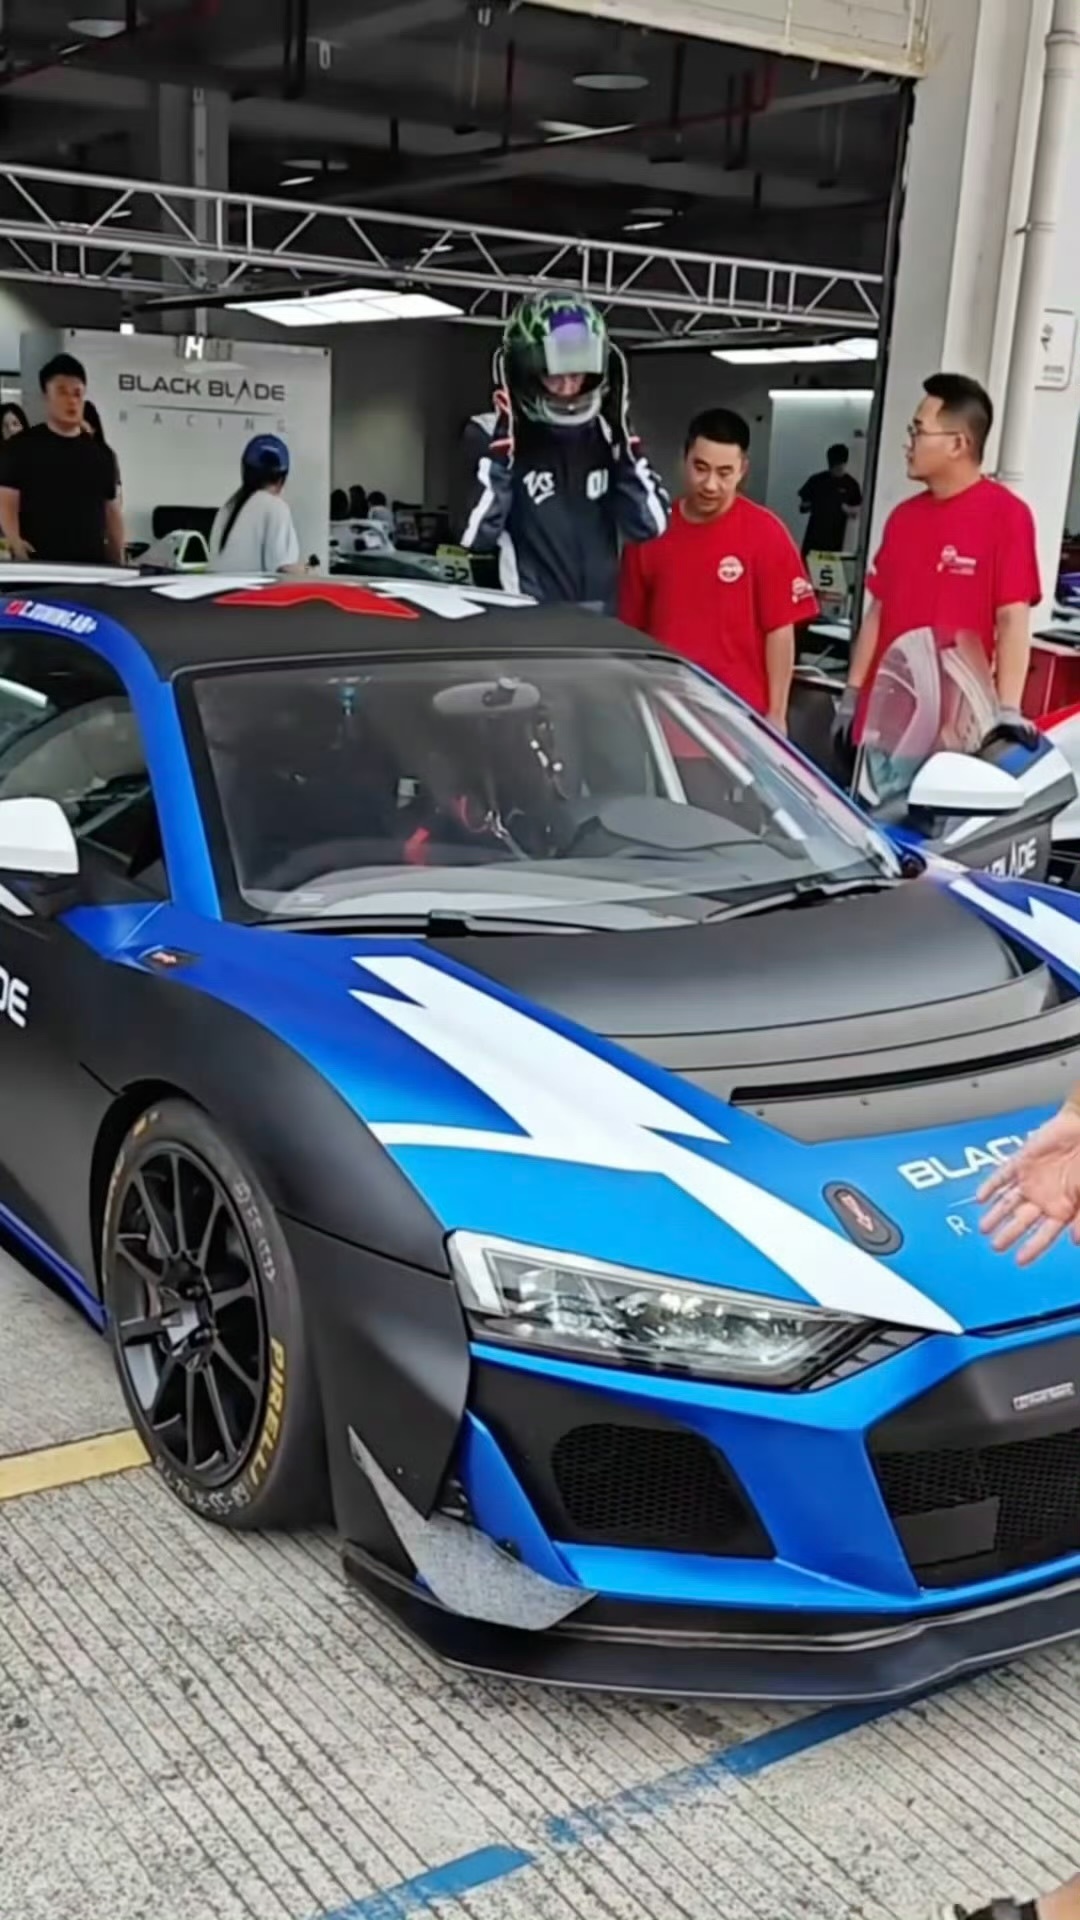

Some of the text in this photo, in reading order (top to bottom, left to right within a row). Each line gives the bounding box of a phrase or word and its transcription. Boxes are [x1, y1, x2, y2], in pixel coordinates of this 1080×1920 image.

[118, 373, 285, 405] BLACK BLADE
[118, 409, 286, 433] RACING
